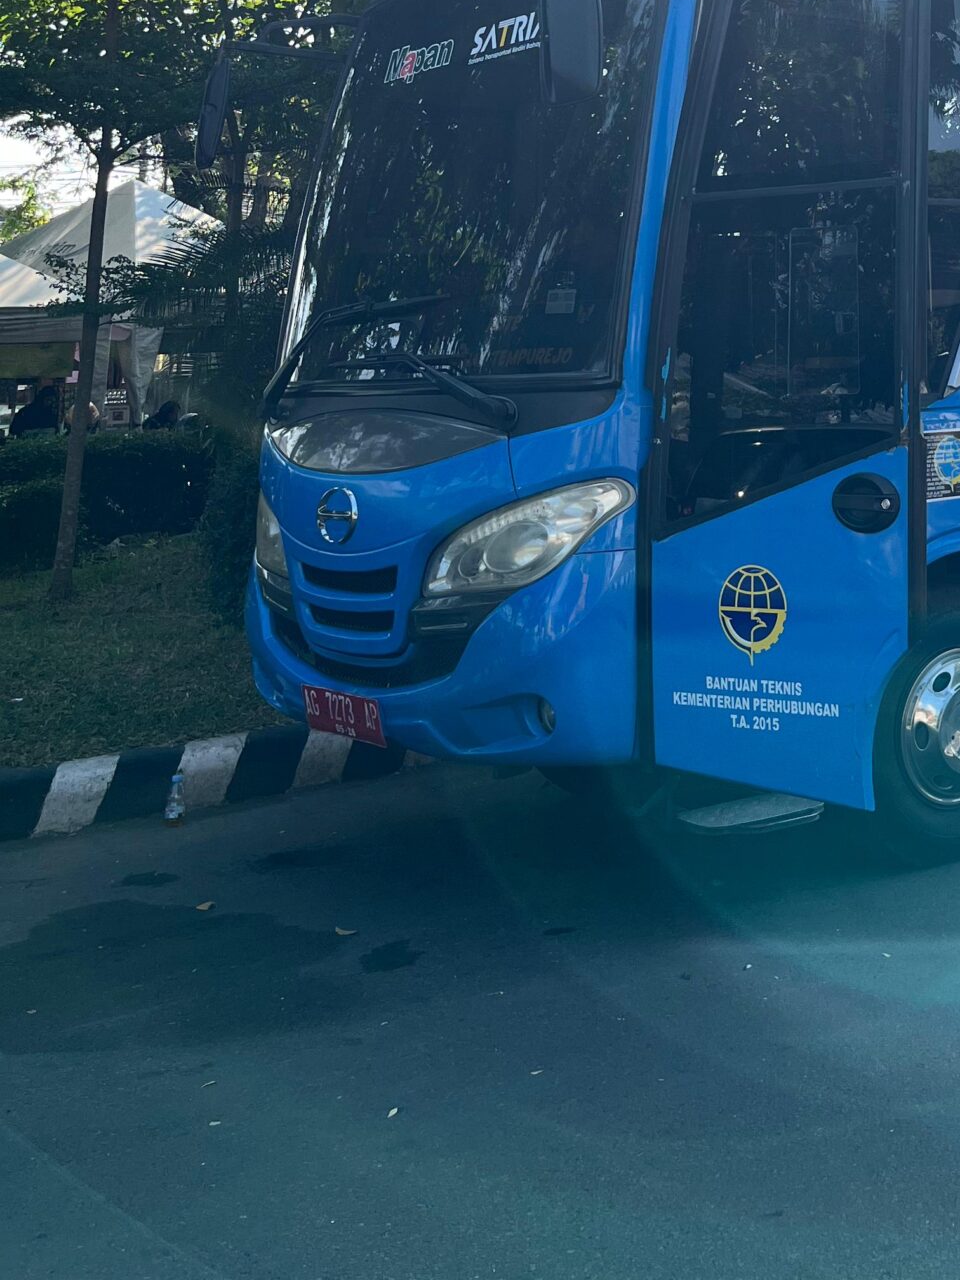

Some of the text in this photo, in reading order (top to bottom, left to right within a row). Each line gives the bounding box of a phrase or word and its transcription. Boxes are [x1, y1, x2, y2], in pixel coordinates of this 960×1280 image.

[384, 39, 454, 84] Mapan
[706, 676, 802, 696] BANTUAN TEKNIS
[304, 688, 377, 731] AG 7273 AP
[673, 691, 839, 717] KEMENTERIAN PERHUBUNGAN
[730, 714, 780, 731] T.A. 2015
